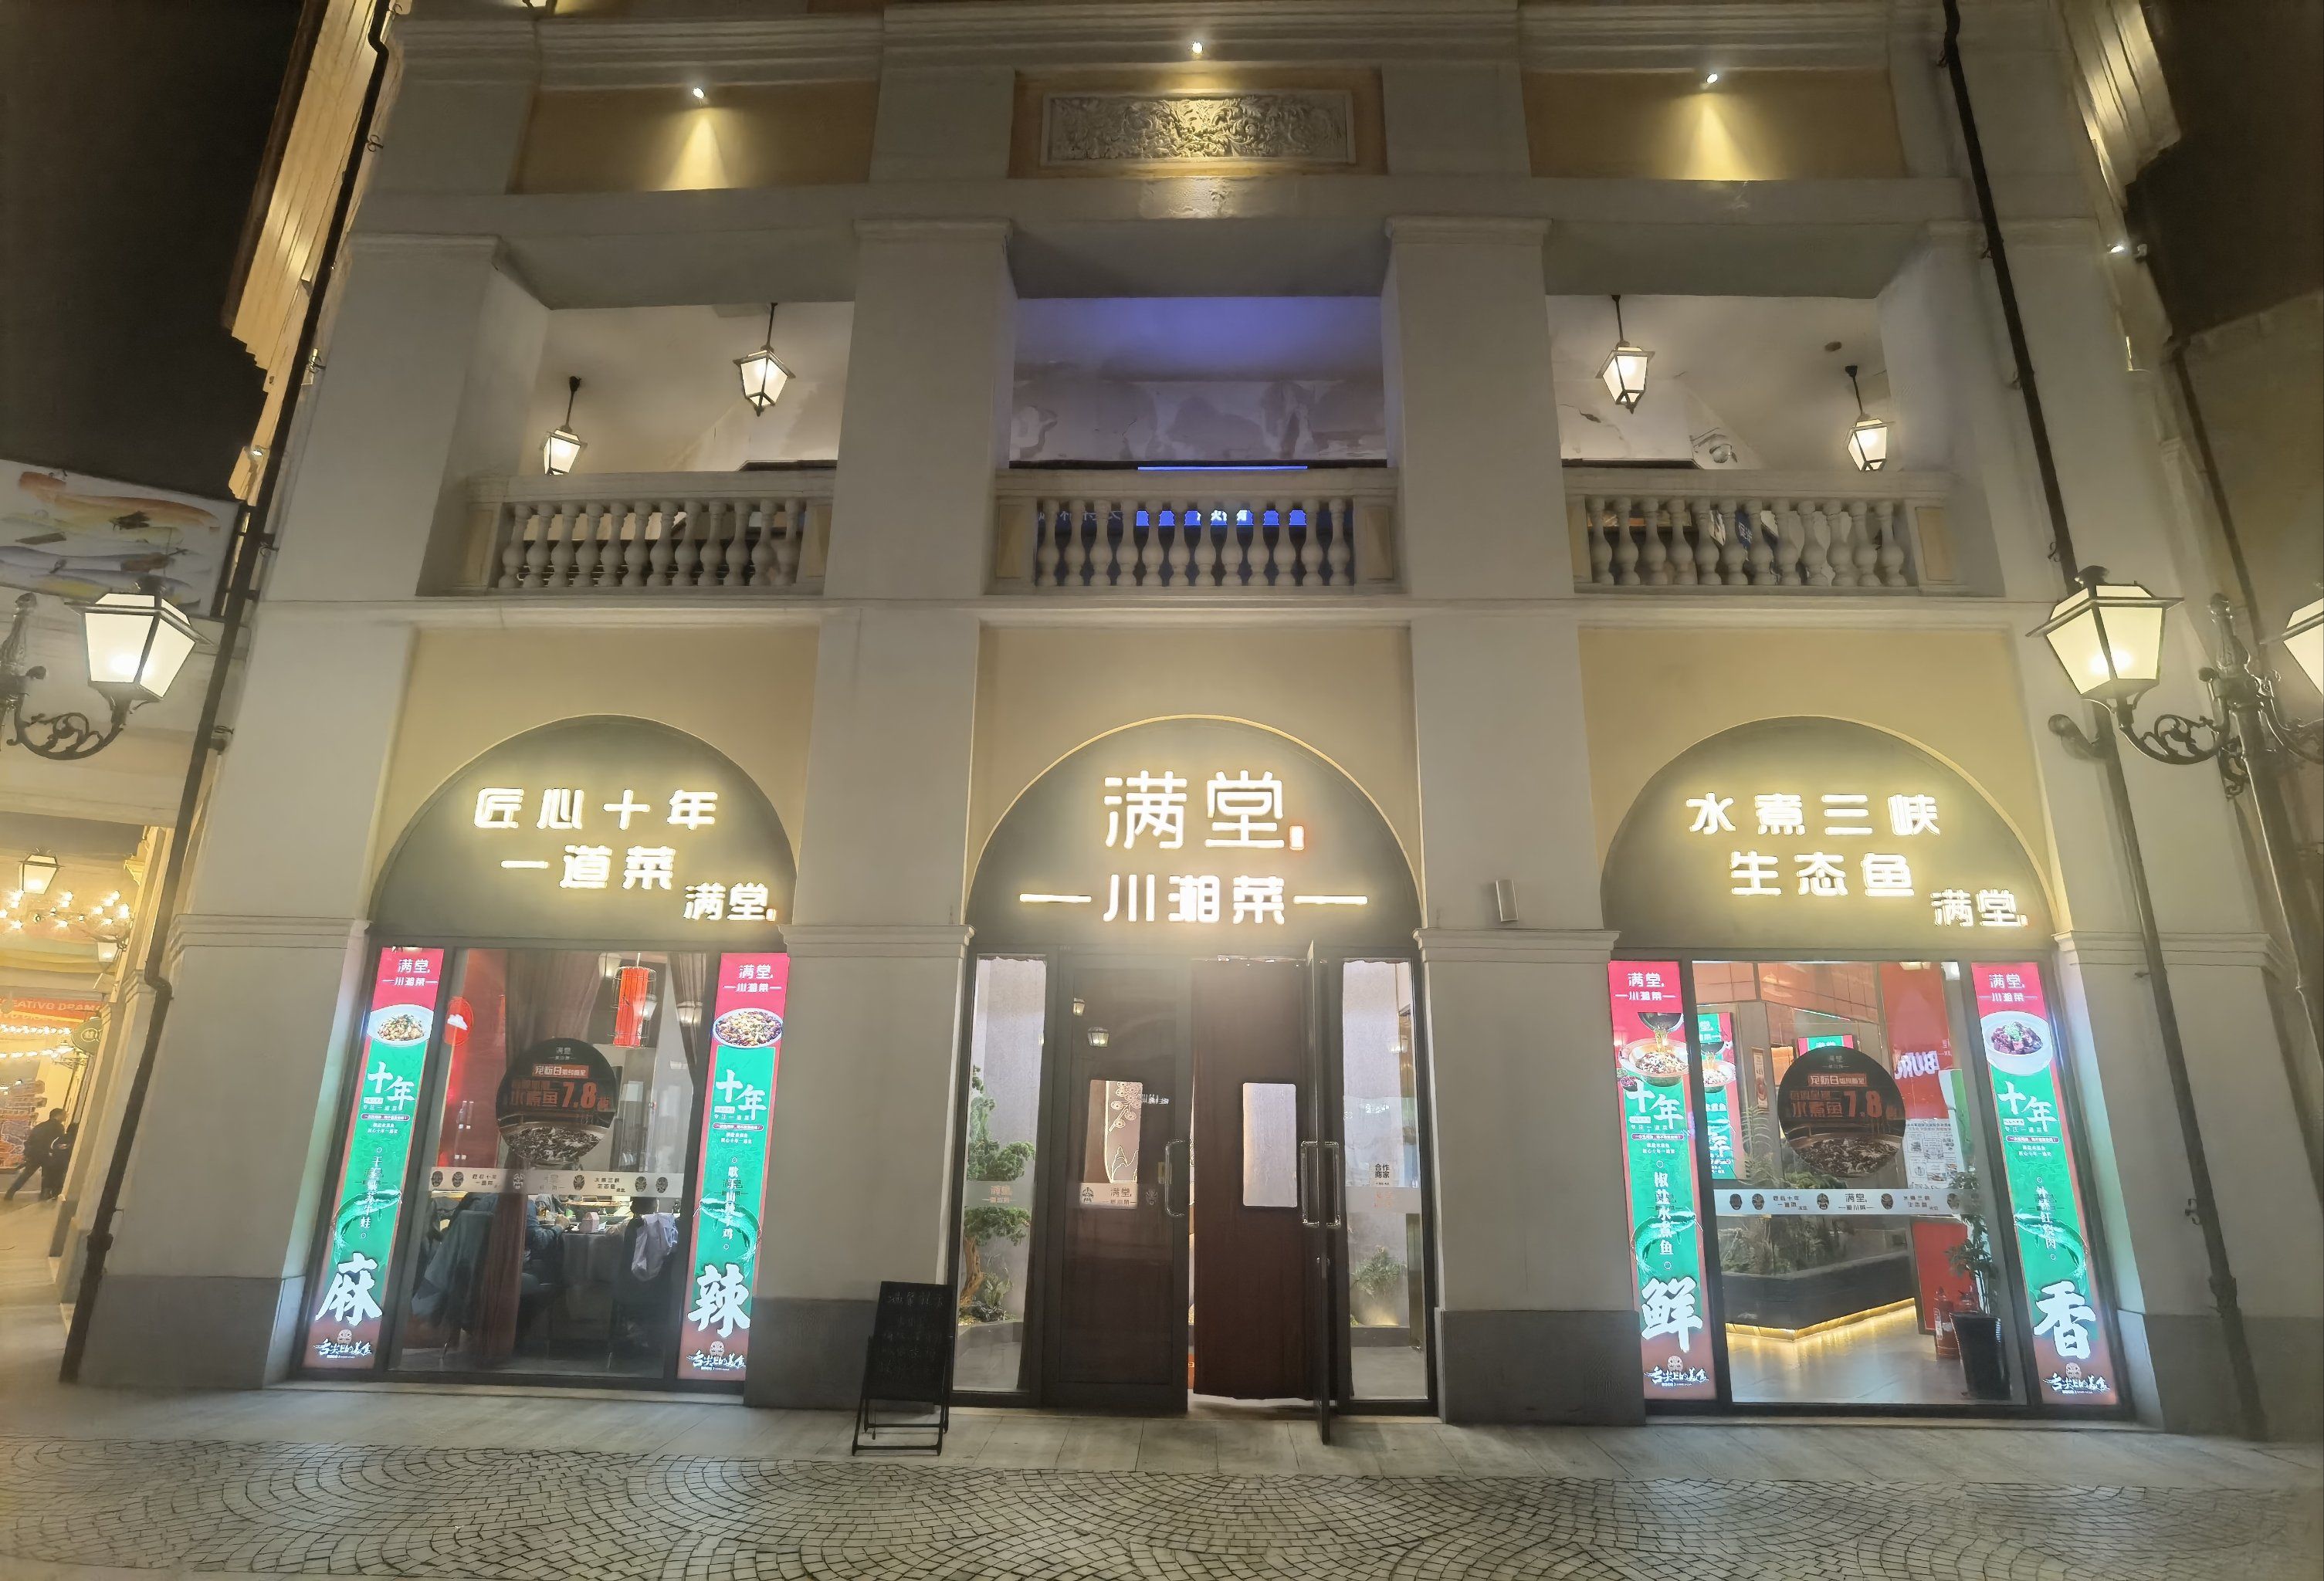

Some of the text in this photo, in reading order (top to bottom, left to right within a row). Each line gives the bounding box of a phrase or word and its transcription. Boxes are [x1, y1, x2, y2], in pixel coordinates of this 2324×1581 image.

[473, 787, 719, 831] 匠心十年
[1103, 770, 1285, 849] 满堂
[1685, 791, 1940, 837] 水煮三峡
[500, 845, 677, 891] 一道菜
[1729, 850, 1915, 897] 生态鱼
[682, 882, 772, 922] 满堂
[1102, 873, 1286, 926] 川湘菜
[1930, 889, 2020, 927] 满堂
[397, 958, 429, 974] 满堂
[738, 963, 772, 980] 满堂
[1627, 971, 1662, 988] 满堂
[1988, 973, 2021, 989] 满堂
[367, 1061, 415, 1111] 十年
[715, 1068, 767, 1120] 十年
[1625, 1079, 1685, 1130] 十年
[1997, 1080, 2058, 1132] 十年
[1845, 1193, 1865, 1203] 满堂
[314, 1251, 383, 1326] 麻
[687, 1263, 750, 1339] 辣
[1641, 1276, 1703, 1353] 鲜
[2033, 1280, 2097, 1359] 香
